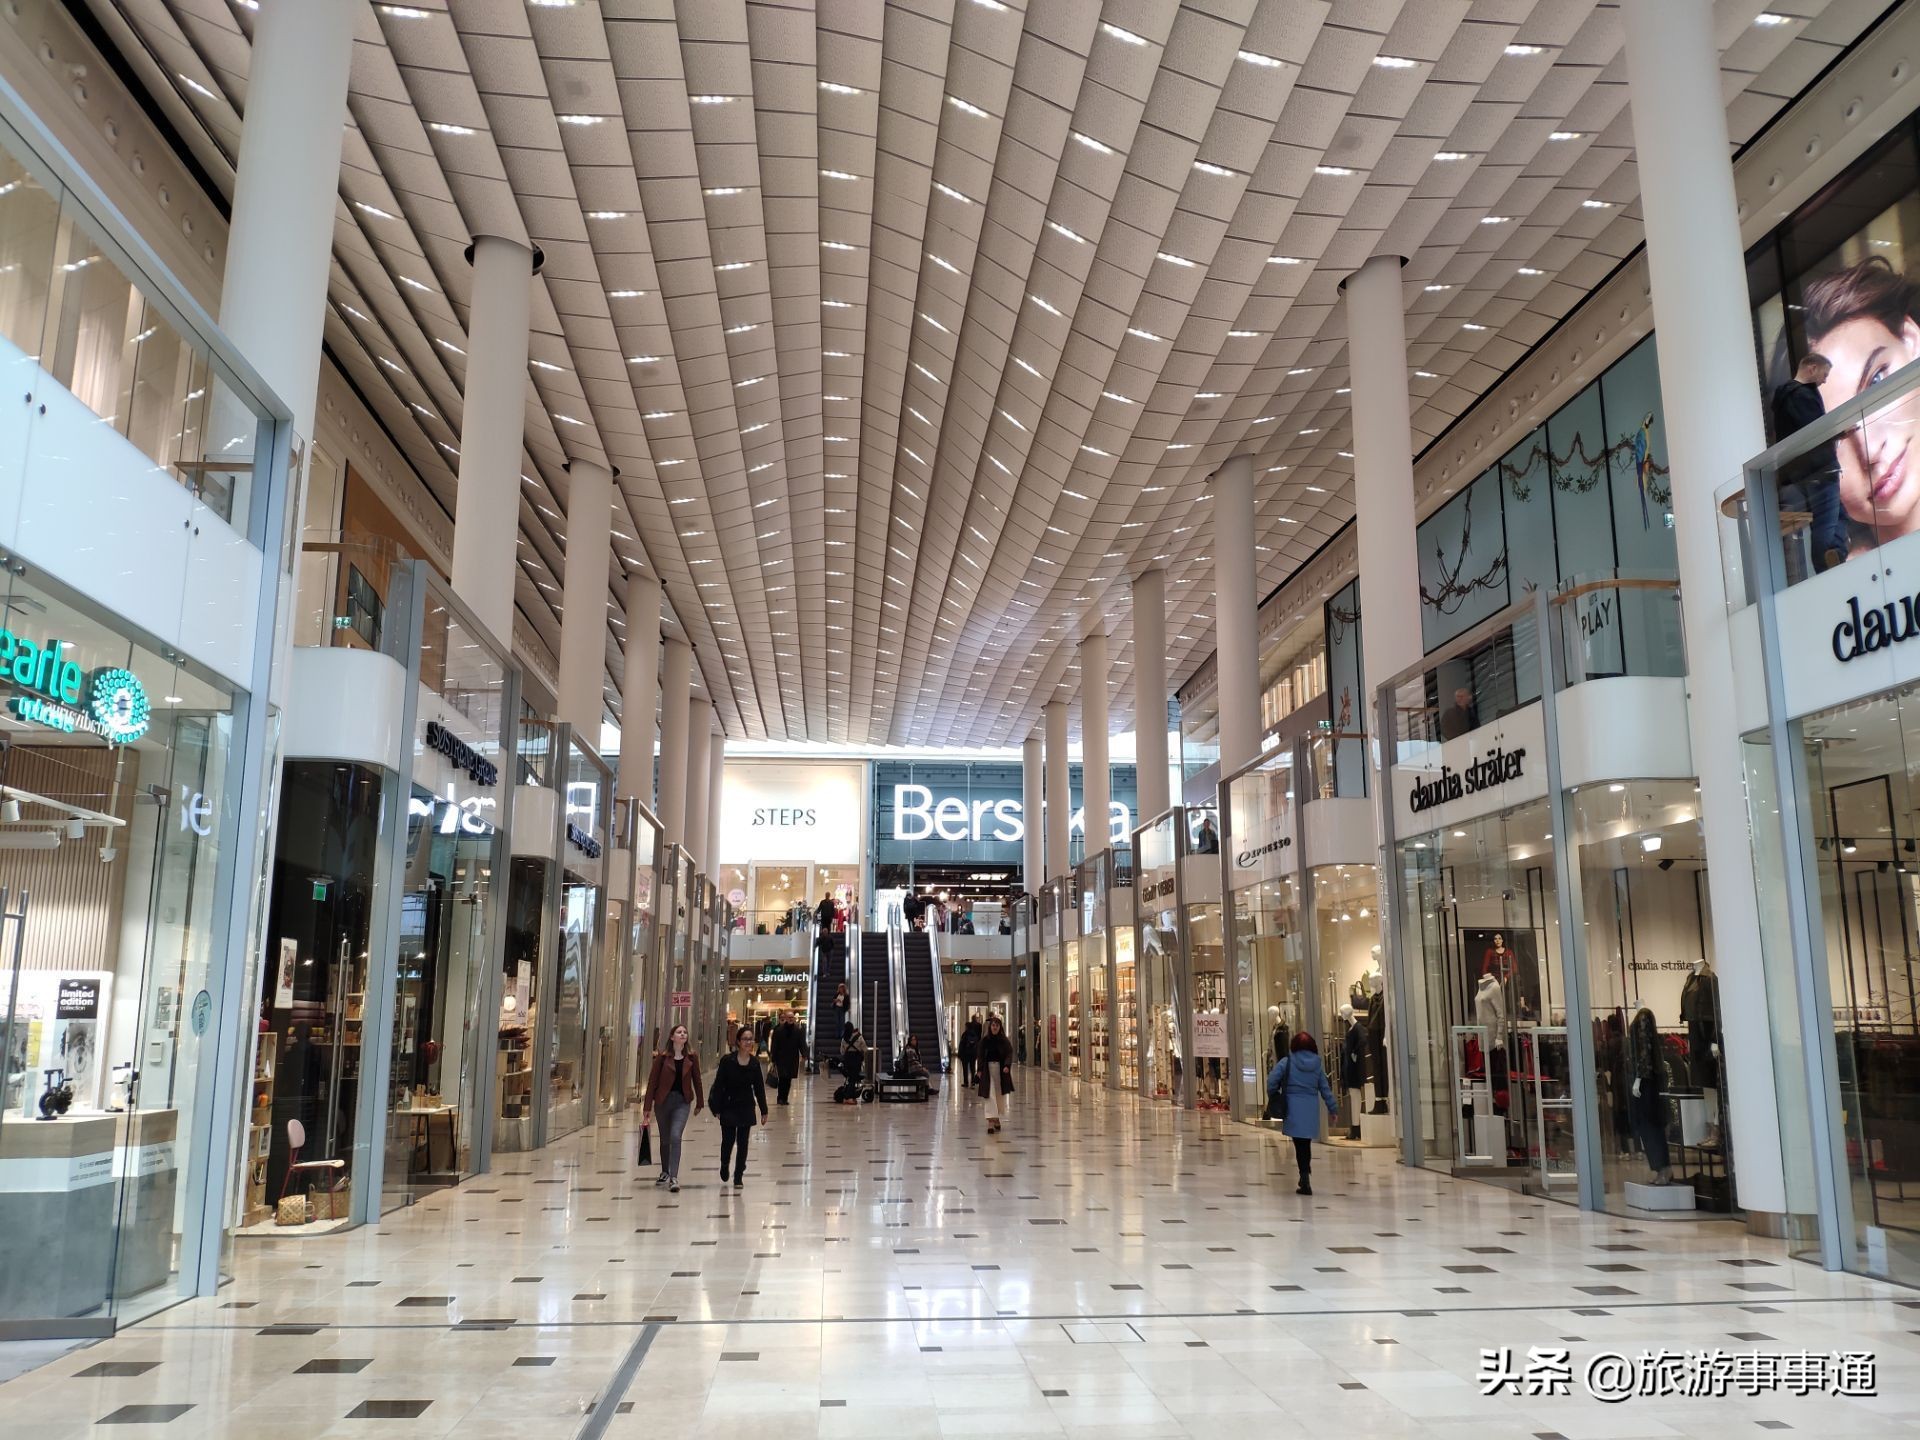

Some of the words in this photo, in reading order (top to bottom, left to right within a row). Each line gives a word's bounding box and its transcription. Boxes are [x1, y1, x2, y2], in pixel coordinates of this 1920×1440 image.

[1581, 598, 1611, 640] PLAY
[1832, 592, 1920, 662] clau
[1410, 766, 1464, 813] claudia
[1465, 747, 1526, 794] sträter
[752, 807, 816, 826] STEPS
[894, 784, 1130, 842] Berska
[60, 997, 94, 1006] edition
[61, 989, 94, 998] limited
